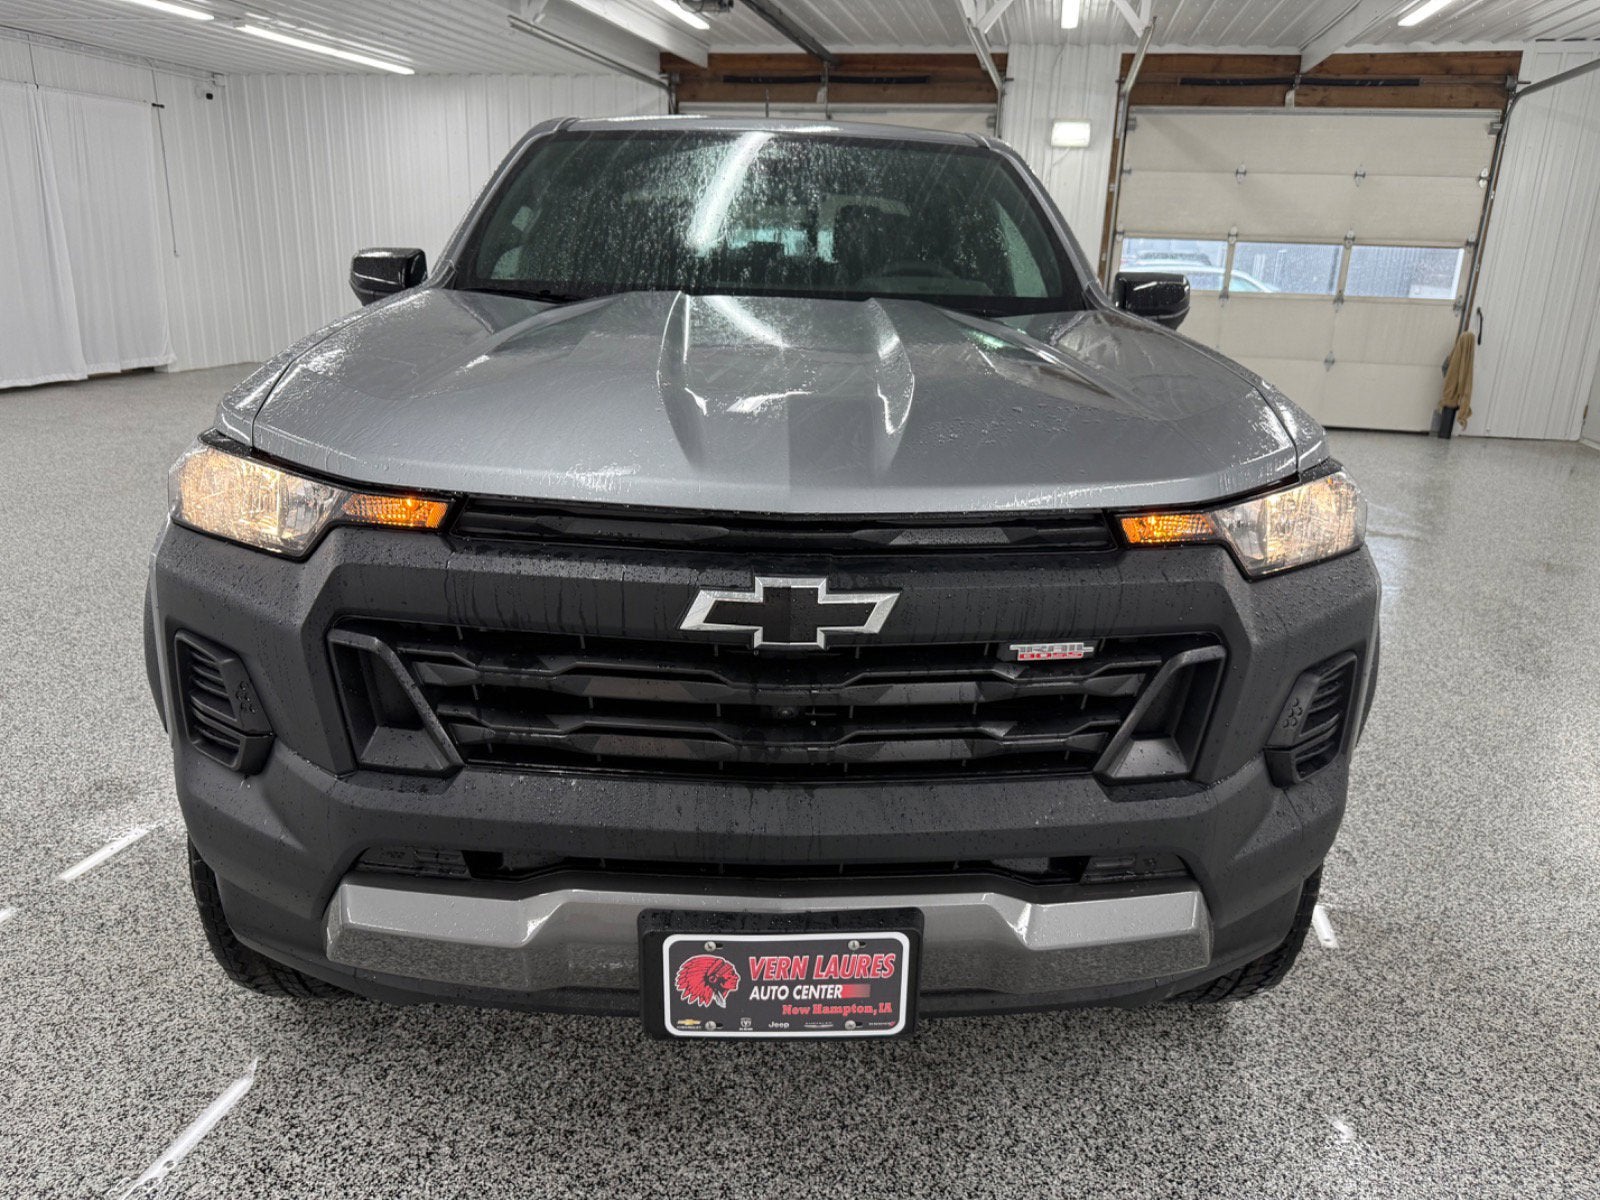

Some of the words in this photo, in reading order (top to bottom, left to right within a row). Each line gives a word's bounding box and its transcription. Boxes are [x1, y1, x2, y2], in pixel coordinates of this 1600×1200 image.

[748, 955, 810, 981] VERN
[813, 953, 896, 979] LAURES
[749, 985, 789, 1000] AUTO
[792, 984, 844, 1000] CENTER
[782, 1004, 811, 1016] New
[812, 1003, 877, 1017] Hampton,
[878, 1002, 893, 1014] IA
[768, 1021, 790, 1029] Jeep
